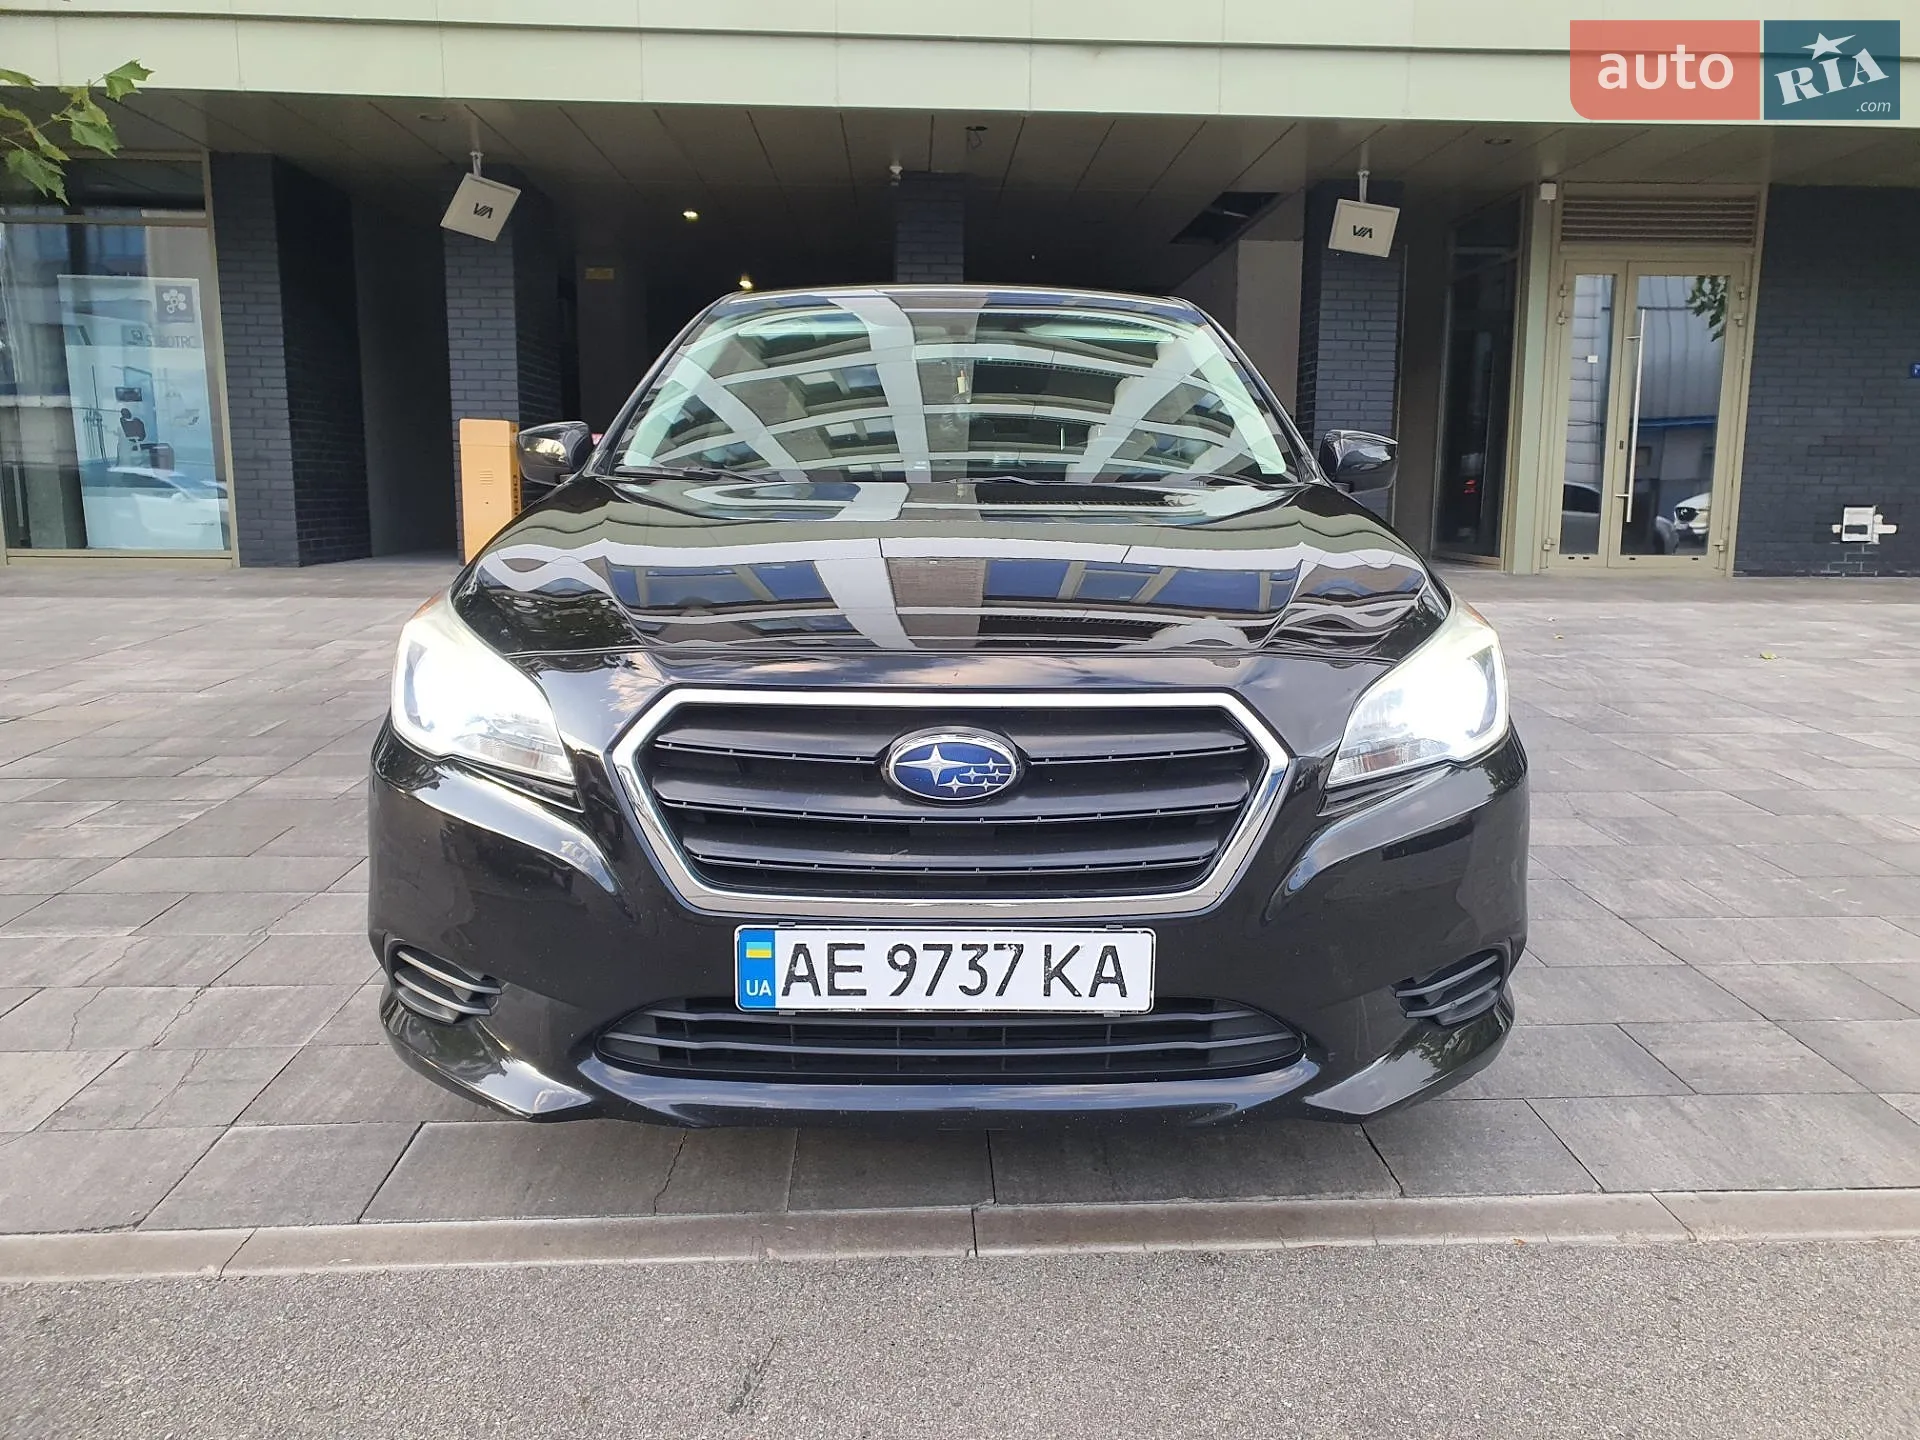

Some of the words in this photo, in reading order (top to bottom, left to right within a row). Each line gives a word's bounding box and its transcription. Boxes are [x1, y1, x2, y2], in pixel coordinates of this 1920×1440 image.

[746, 979, 772, 996] UA
[781, 943, 867, 997] AE
[886, 943, 1024, 997] 9737
[1043, 944, 1128, 998] KA
